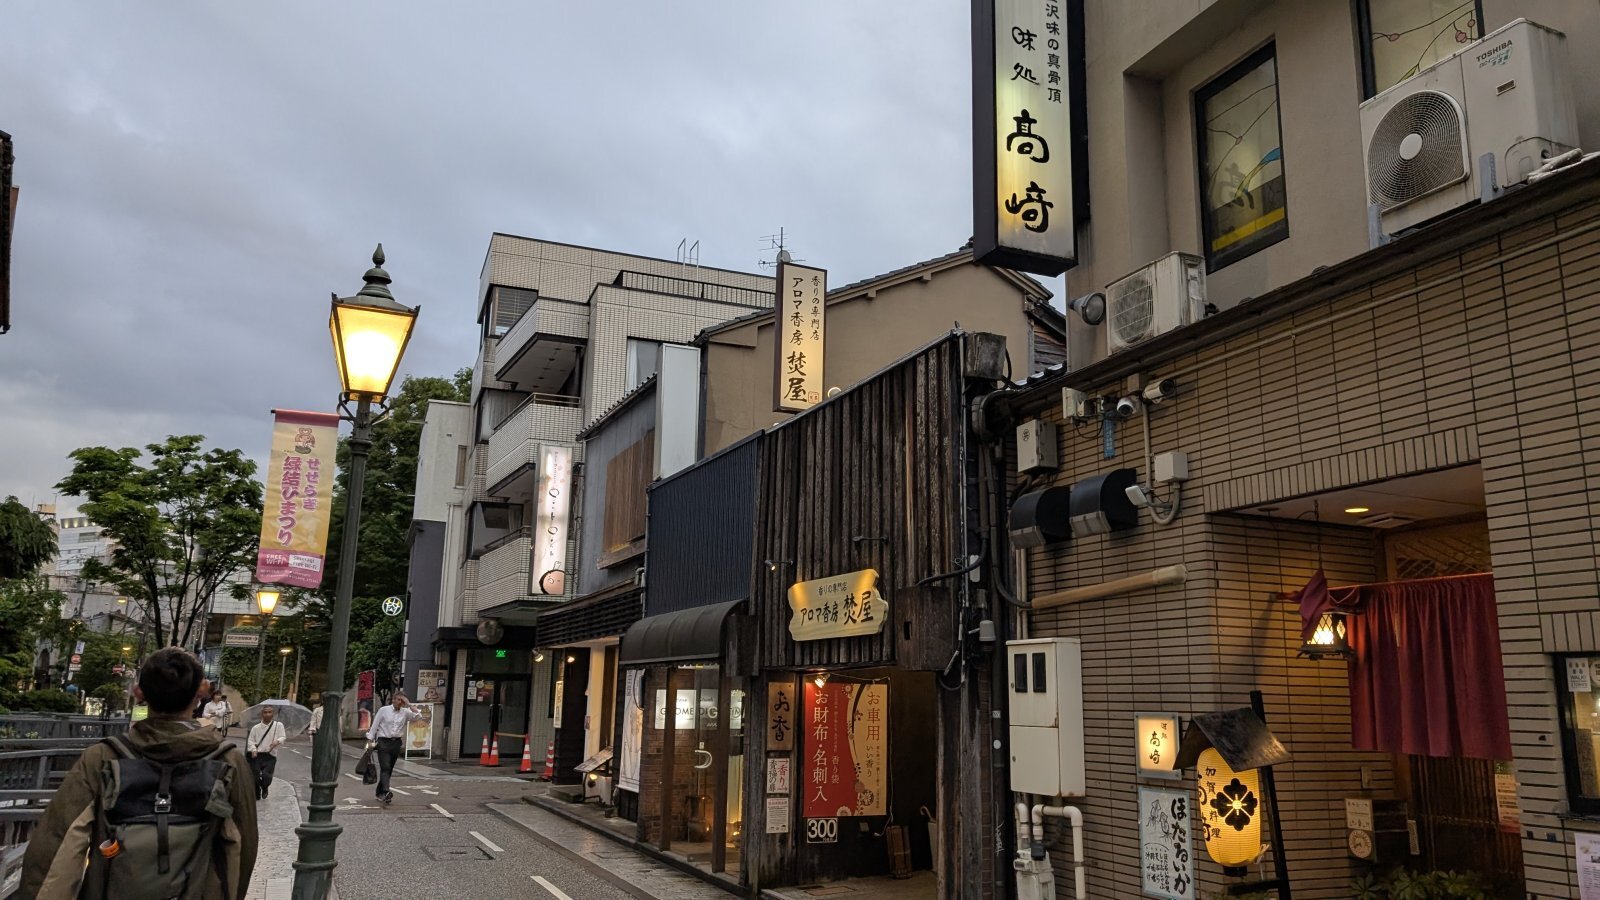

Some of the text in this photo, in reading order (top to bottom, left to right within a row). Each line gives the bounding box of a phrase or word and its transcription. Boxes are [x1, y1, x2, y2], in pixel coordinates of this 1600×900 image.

[1011, 26, 1040, 86] 味処
[1476, 39, 1513, 62] TOSHIBA
[810, 275, 821, 341] 香りの専門店
[784, 277, 807, 402] アロマ香房 焚屋
[303, 458, 321, 511] せせらぎ
[800, 591, 874, 626] アロマ香房 焚屋
[818, 582, 848, 596] 香りの専門店
[771, 690, 791, 742] お香
[865, 691, 881, 741] お車用
[812, 691, 829, 802] お財布・名刺入
[807, 819, 836, 838] 300
[1171, 798, 1191, 896] ほたるいか
